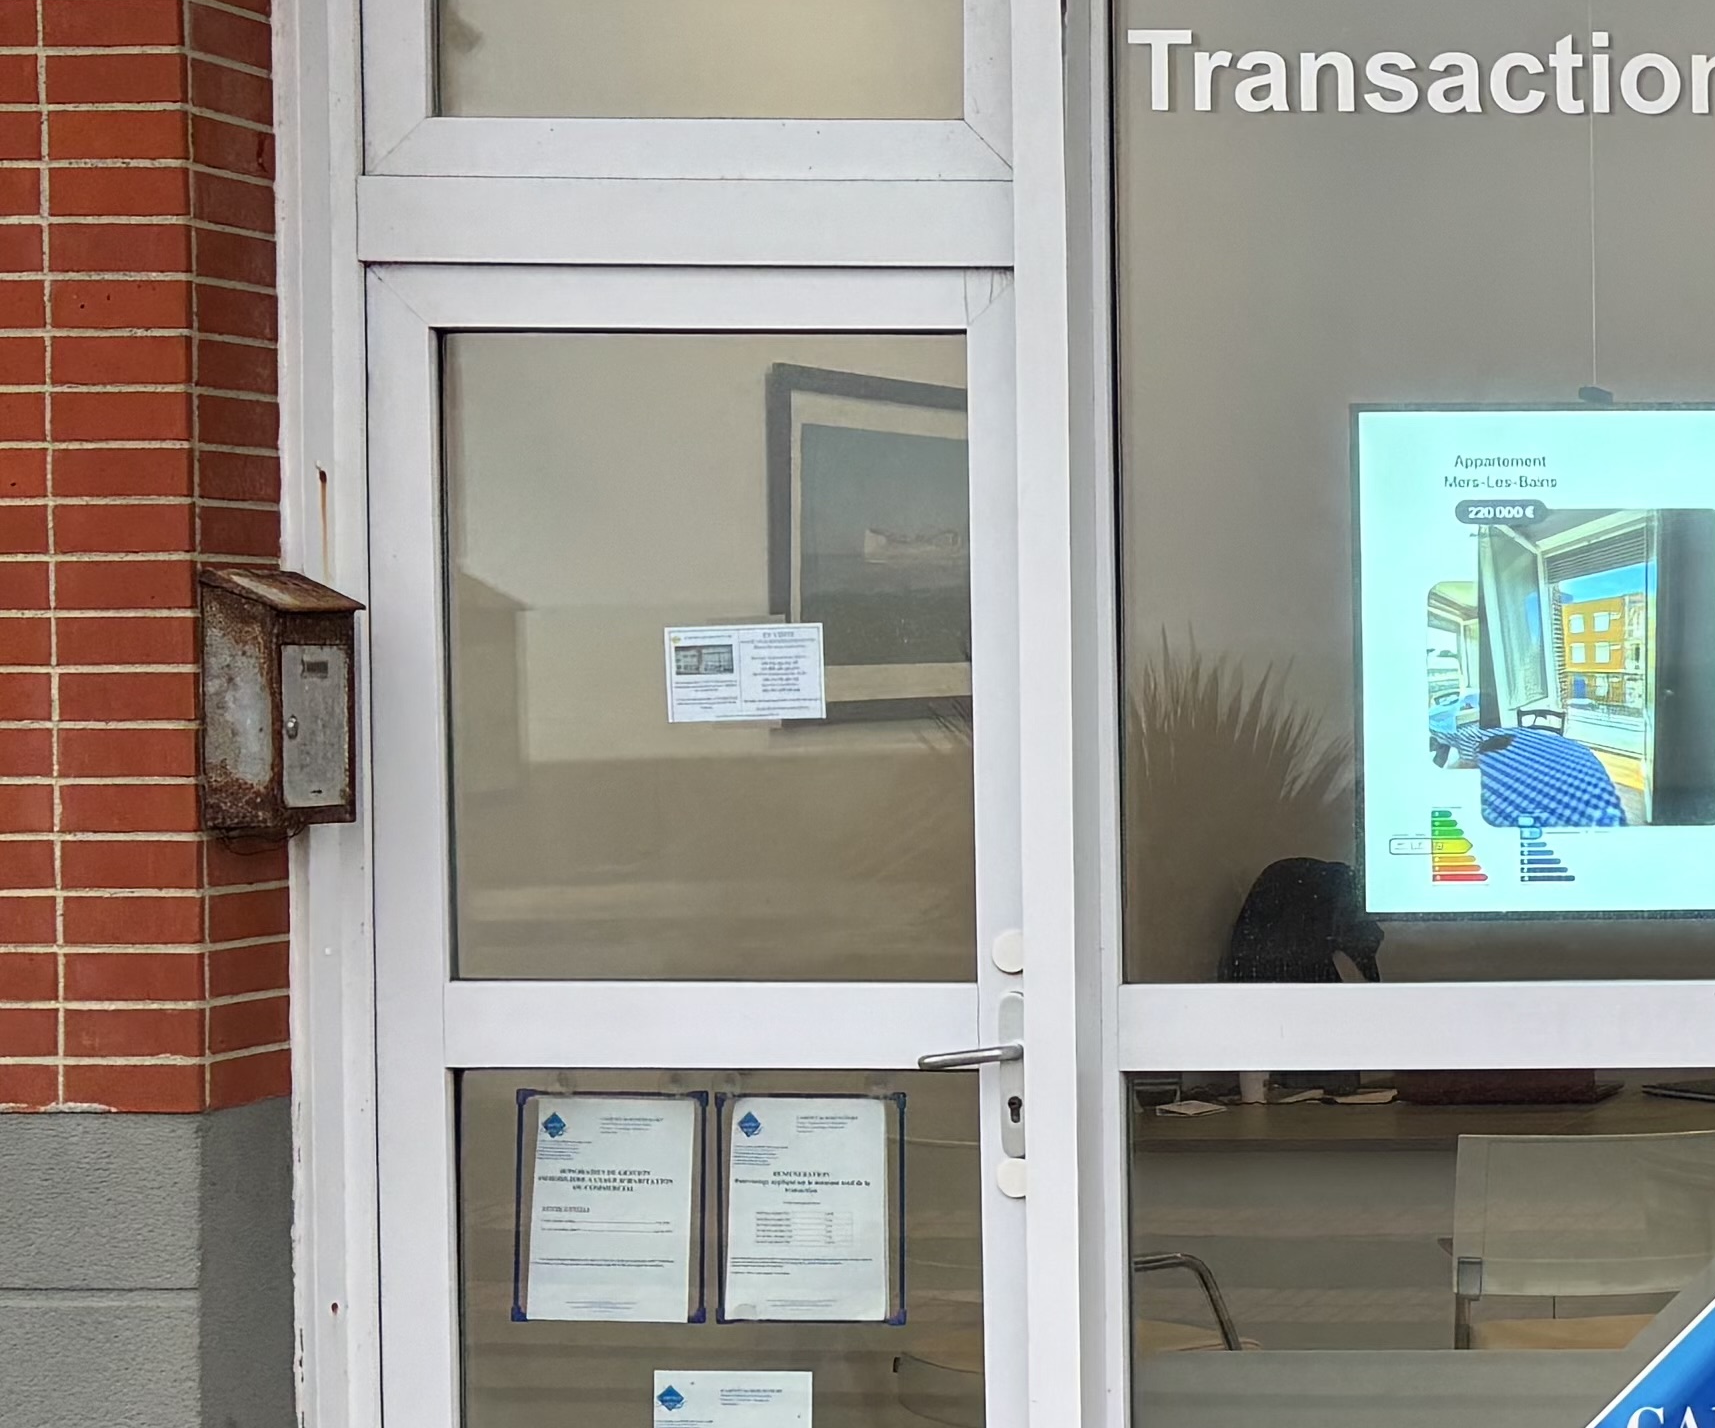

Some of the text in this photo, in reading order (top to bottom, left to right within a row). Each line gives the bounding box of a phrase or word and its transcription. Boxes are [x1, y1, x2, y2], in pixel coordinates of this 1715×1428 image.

[1454, 455, 1546, 470] Appartement
[1468, 505, 1534, 519] 220 000 €
